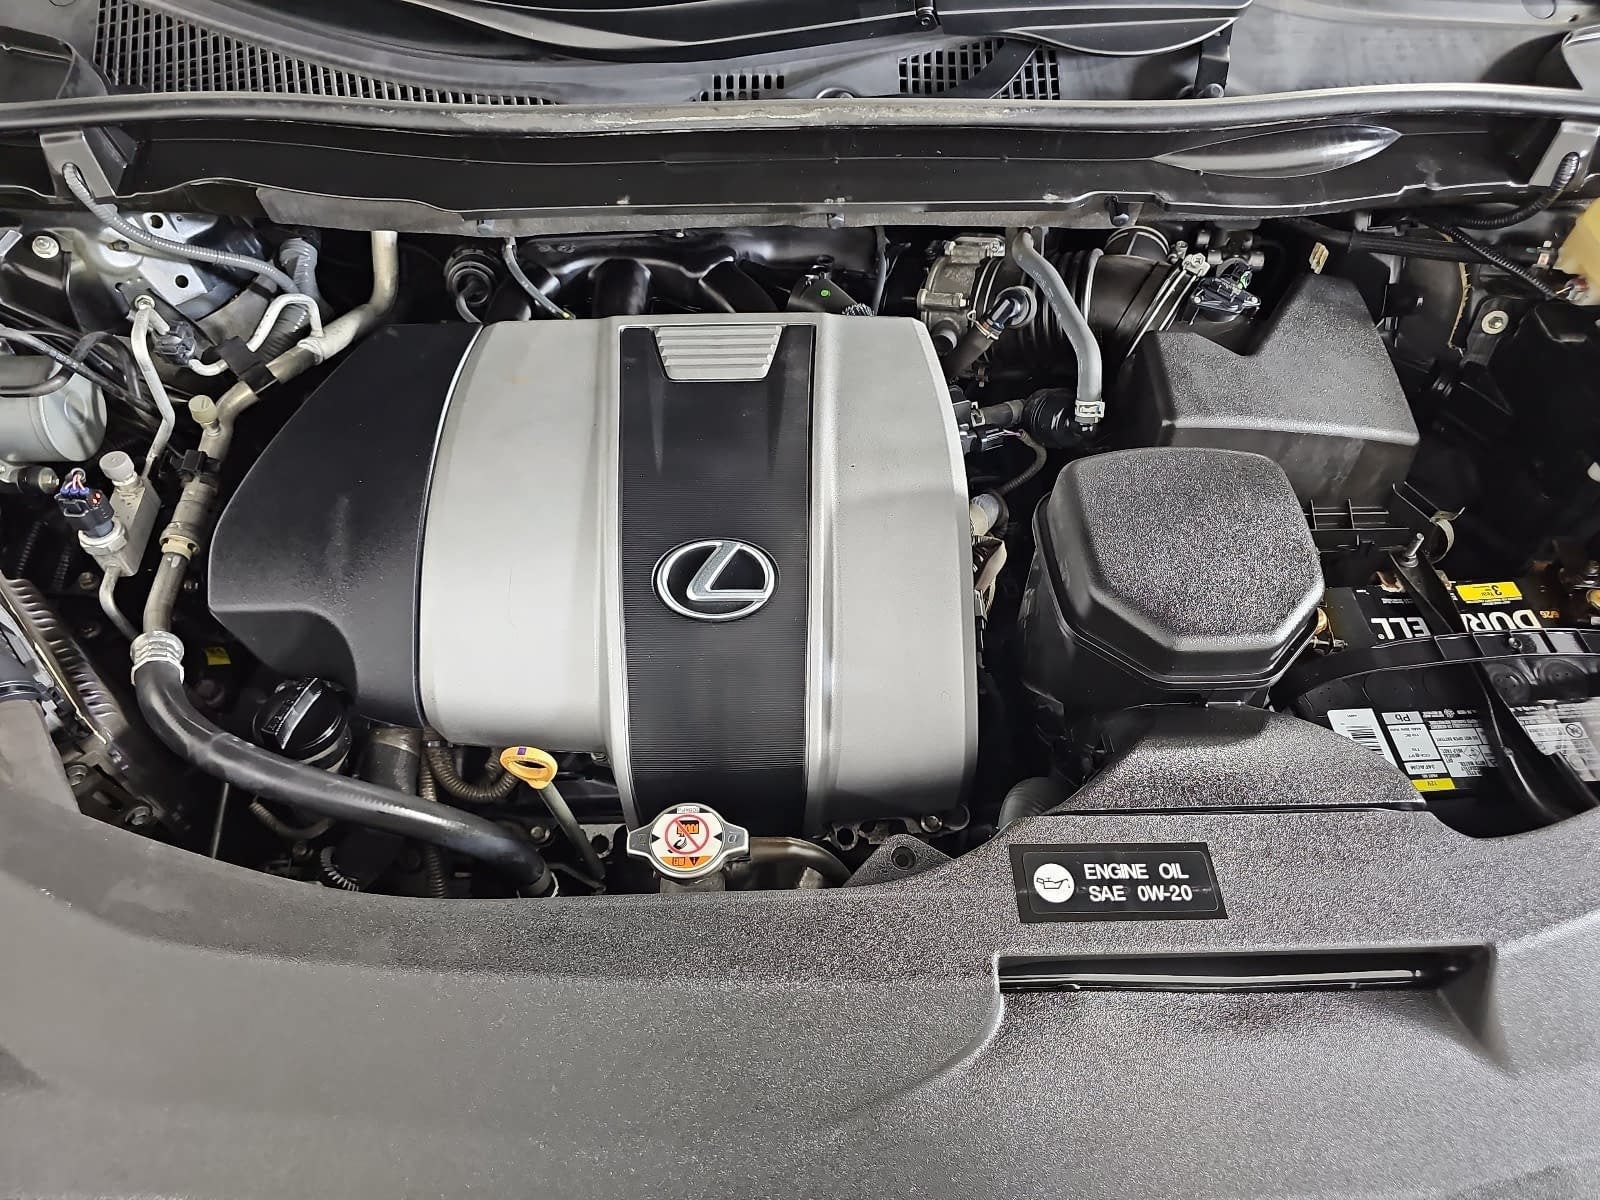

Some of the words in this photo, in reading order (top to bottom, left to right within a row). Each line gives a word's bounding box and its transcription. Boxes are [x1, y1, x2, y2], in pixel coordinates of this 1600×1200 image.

[1491, 585, 1503, 596] 3
[1394, 713, 1411, 722] Pb
[1083, 863, 1149, 880] ENGINE
[1158, 863, 1190, 879] OIL
[1088, 885, 1127, 902] SAE
[1137, 885, 1193, 902] 0W-20
